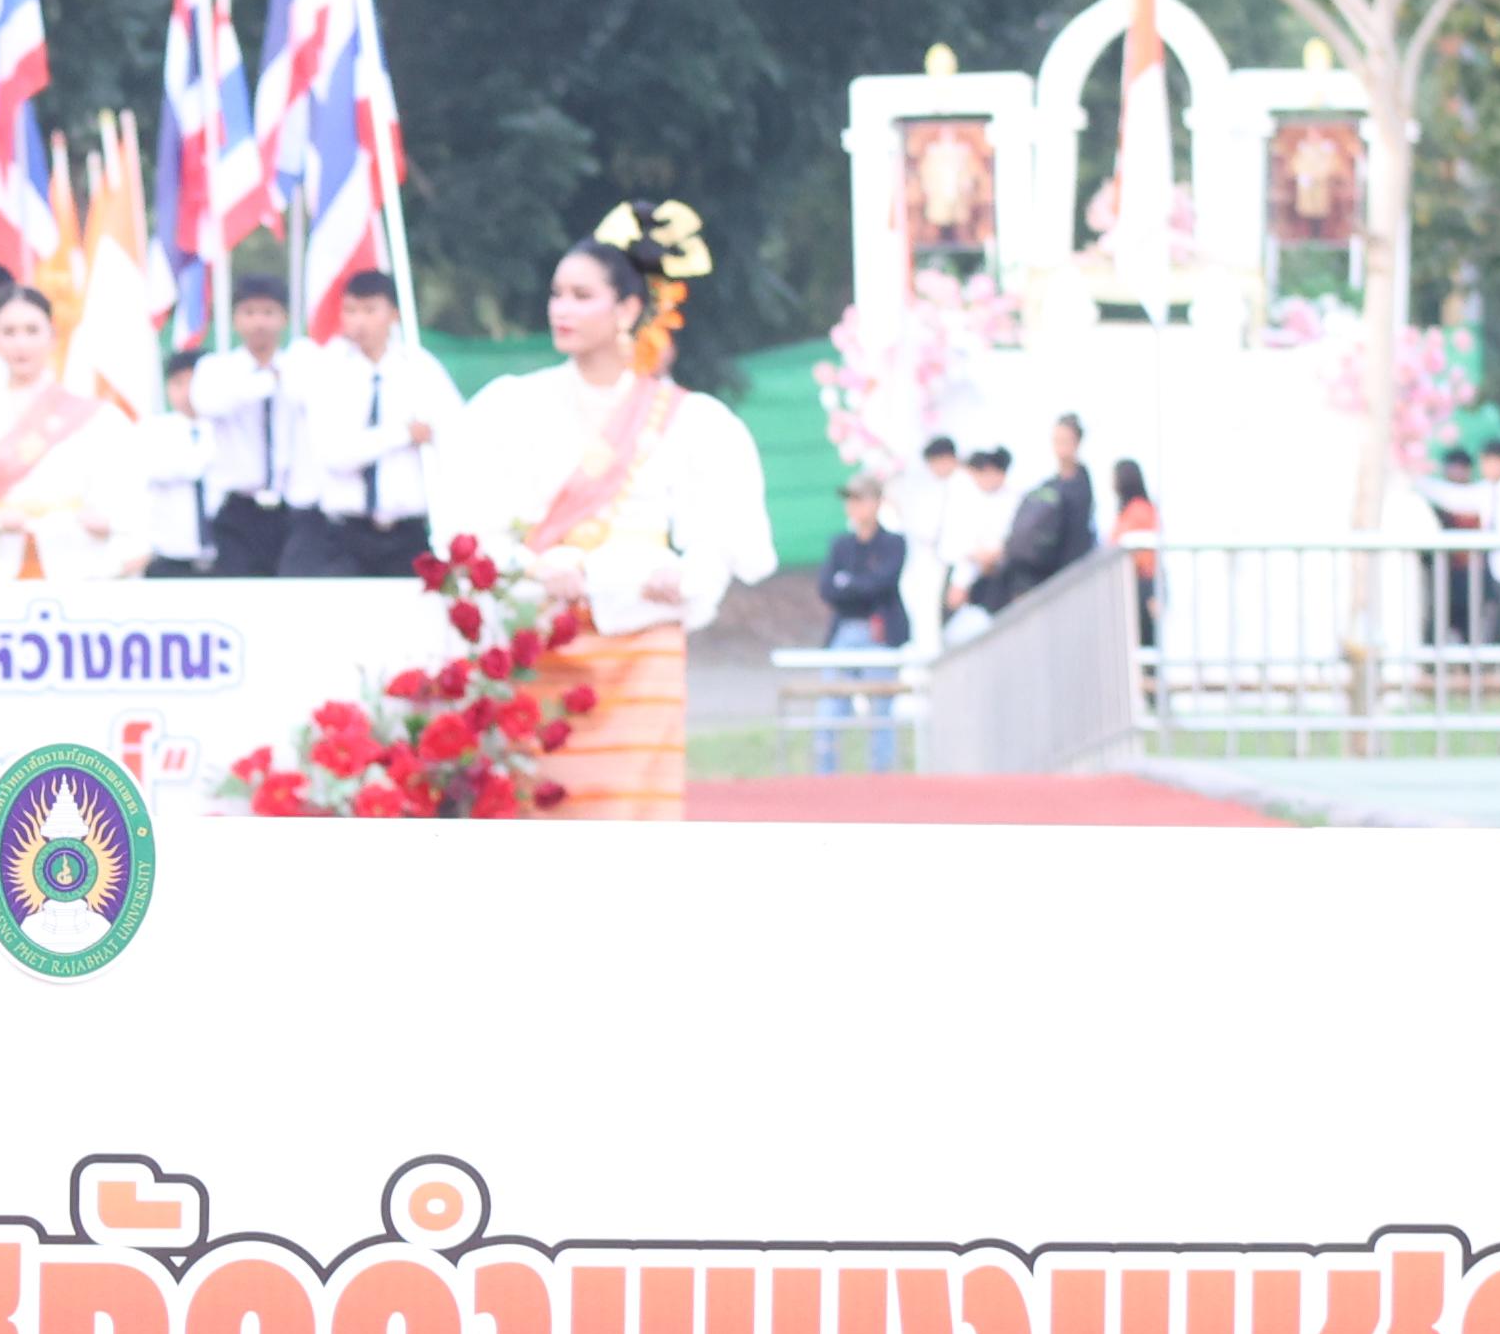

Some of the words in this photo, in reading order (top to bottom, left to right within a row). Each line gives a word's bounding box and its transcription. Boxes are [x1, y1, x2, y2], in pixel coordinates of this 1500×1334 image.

[13, 940, 48, 969] PHET
[50, 938, 120, 975] RAJABHAT
[116, 859, 150, 941] UNIVERSITY
